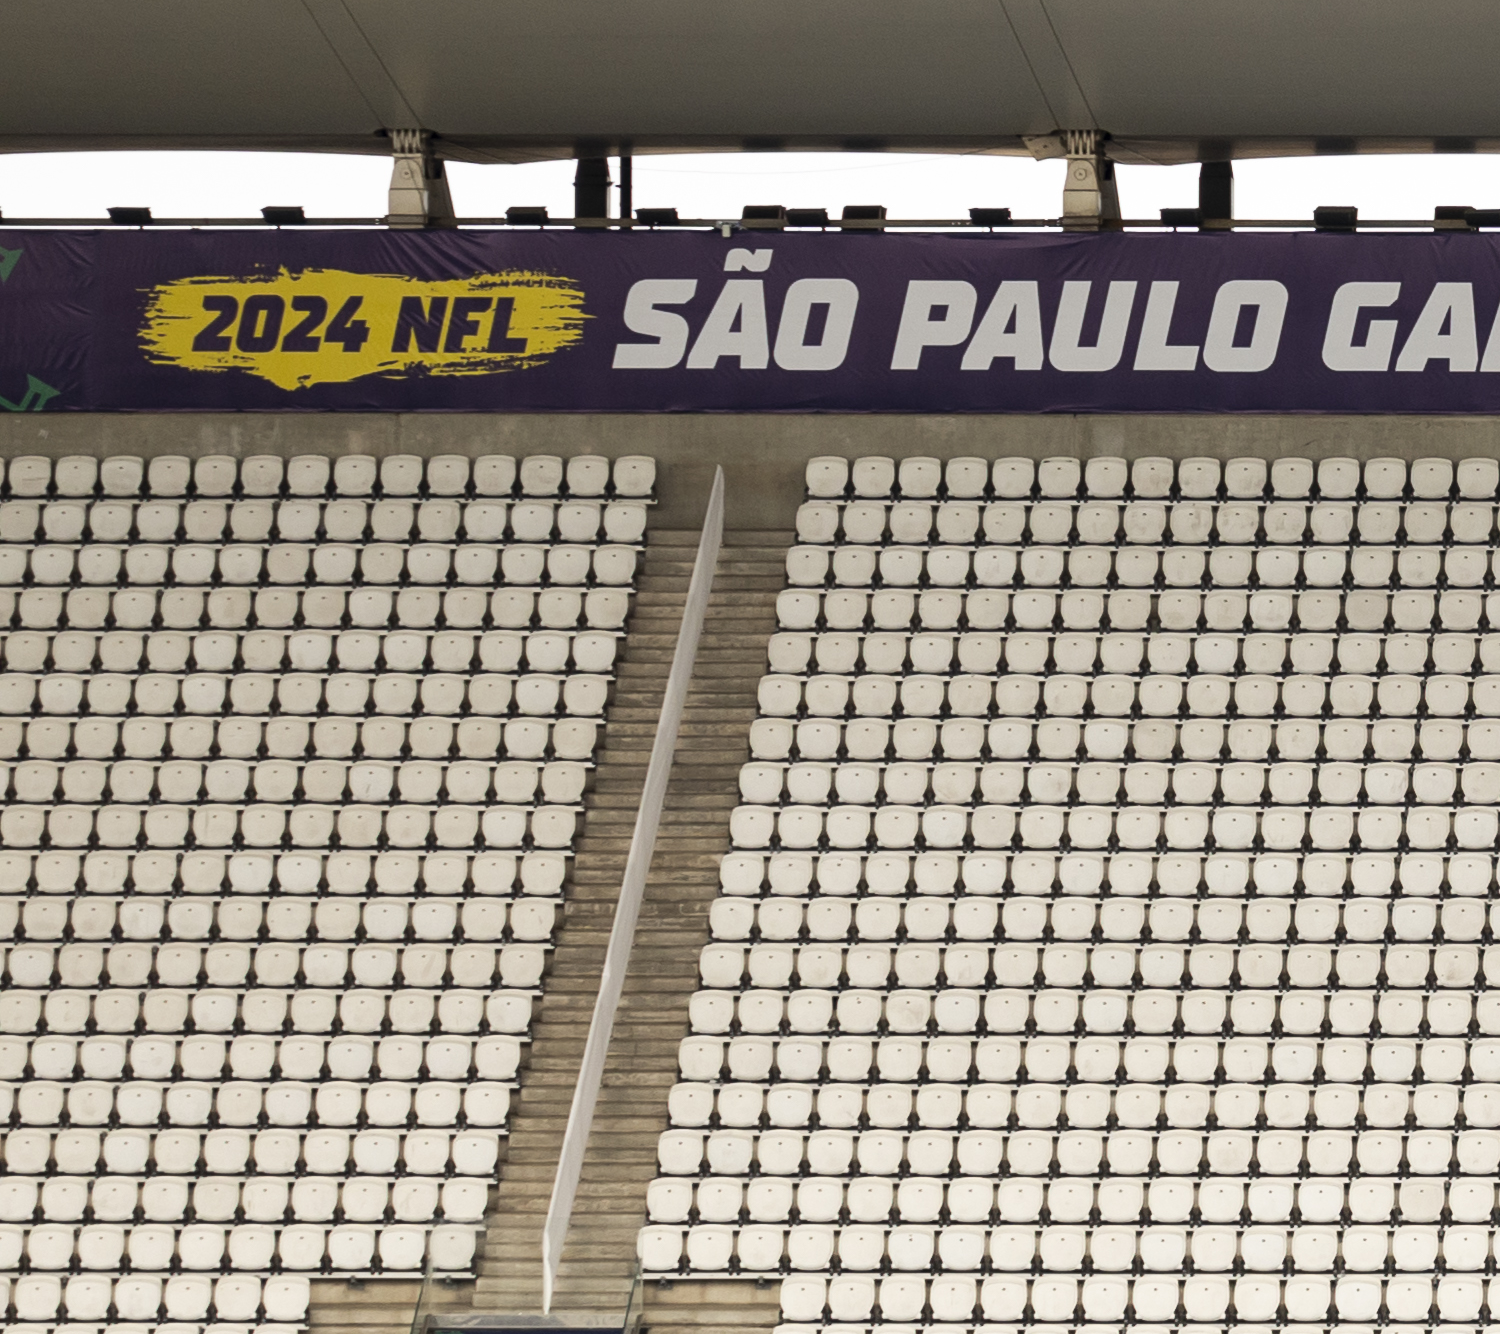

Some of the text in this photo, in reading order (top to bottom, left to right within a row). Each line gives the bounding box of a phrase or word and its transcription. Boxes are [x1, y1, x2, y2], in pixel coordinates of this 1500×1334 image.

[192, 294, 529, 354] 2024 NFL
[613, 248, 860, 371] SÃO
[890, 278, 1288, 373] PAULO
